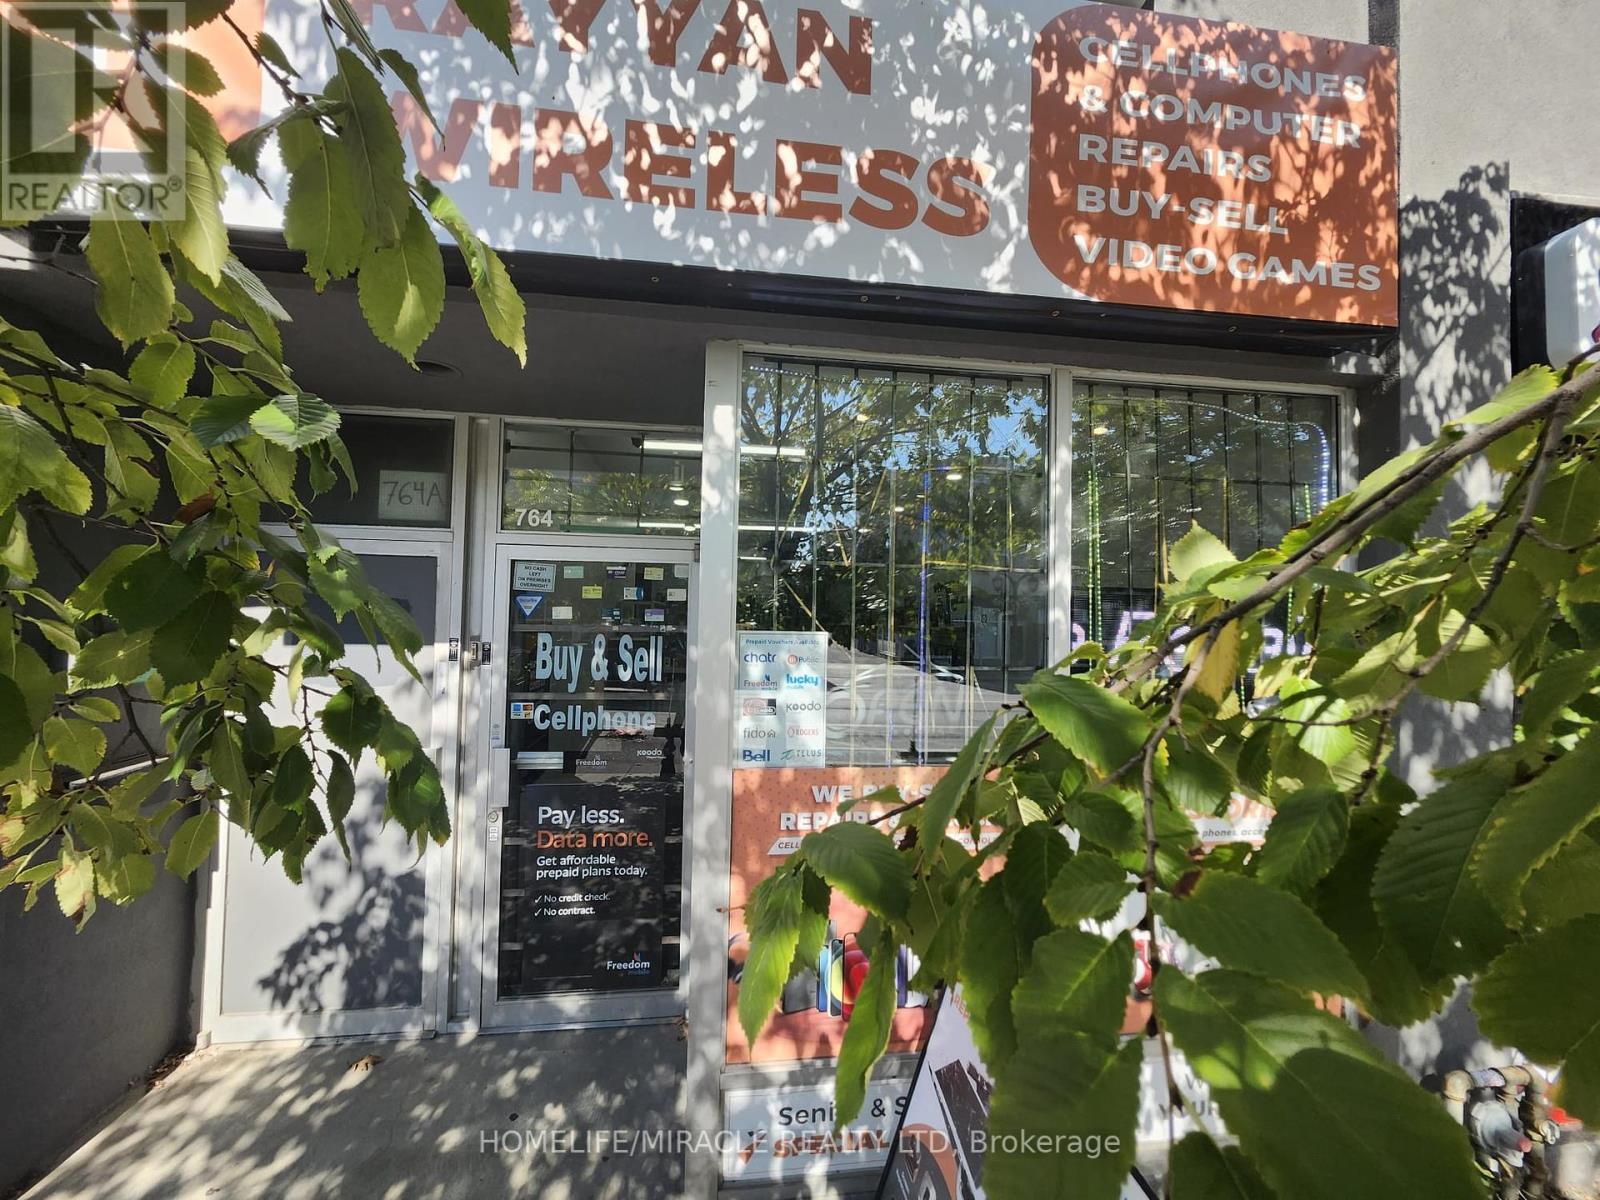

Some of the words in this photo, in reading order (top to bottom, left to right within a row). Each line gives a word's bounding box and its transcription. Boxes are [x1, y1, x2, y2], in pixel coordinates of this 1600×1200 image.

[1078, 36, 1367, 102] CELLPHONES
[1080, 85, 1109, 114] &
[1119, 90, 1361, 149] COMPUTER
[1078, 133, 1272, 182] REPAIRS
[1076, 184, 1288, 235] BUY-SELL
[1074, 234, 1217, 276] VIDEO
[1228, 251, 1382, 291] GAMES
[382, 481, 443, 507] 764A
[515, 509, 553, 527] 764
[535, 632, 583, 693] Buy
[590, 633, 609, 681] &
[617, 634, 663, 682] Sell
[744, 652, 776, 663] chatr
[786, 673, 818, 686] lucky
[534, 704, 656, 736] Cellphone
[575, 757, 608, 766] Freedom
[742, 749, 770, 762] Bell
[811, 785, 852, 803] WE
[538, 806, 575, 828] Pay
[581, 805, 625, 824] less.
[536, 830, 587, 849] Data
[592, 832, 653, 848] more.
[536, 856, 557, 866] Get
[559, 854, 616, 866] affordable
[536, 867, 579, 880] prepaid
[581, 866, 611, 879] plans
[614, 865, 648, 877] today.
[558, 893, 583, 901] credit
[584, 893, 610, 901] check.
[558, 906, 596, 915] contract.
[606, 960, 650, 970] Freedom
[871, 1098, 886, 1118] &
